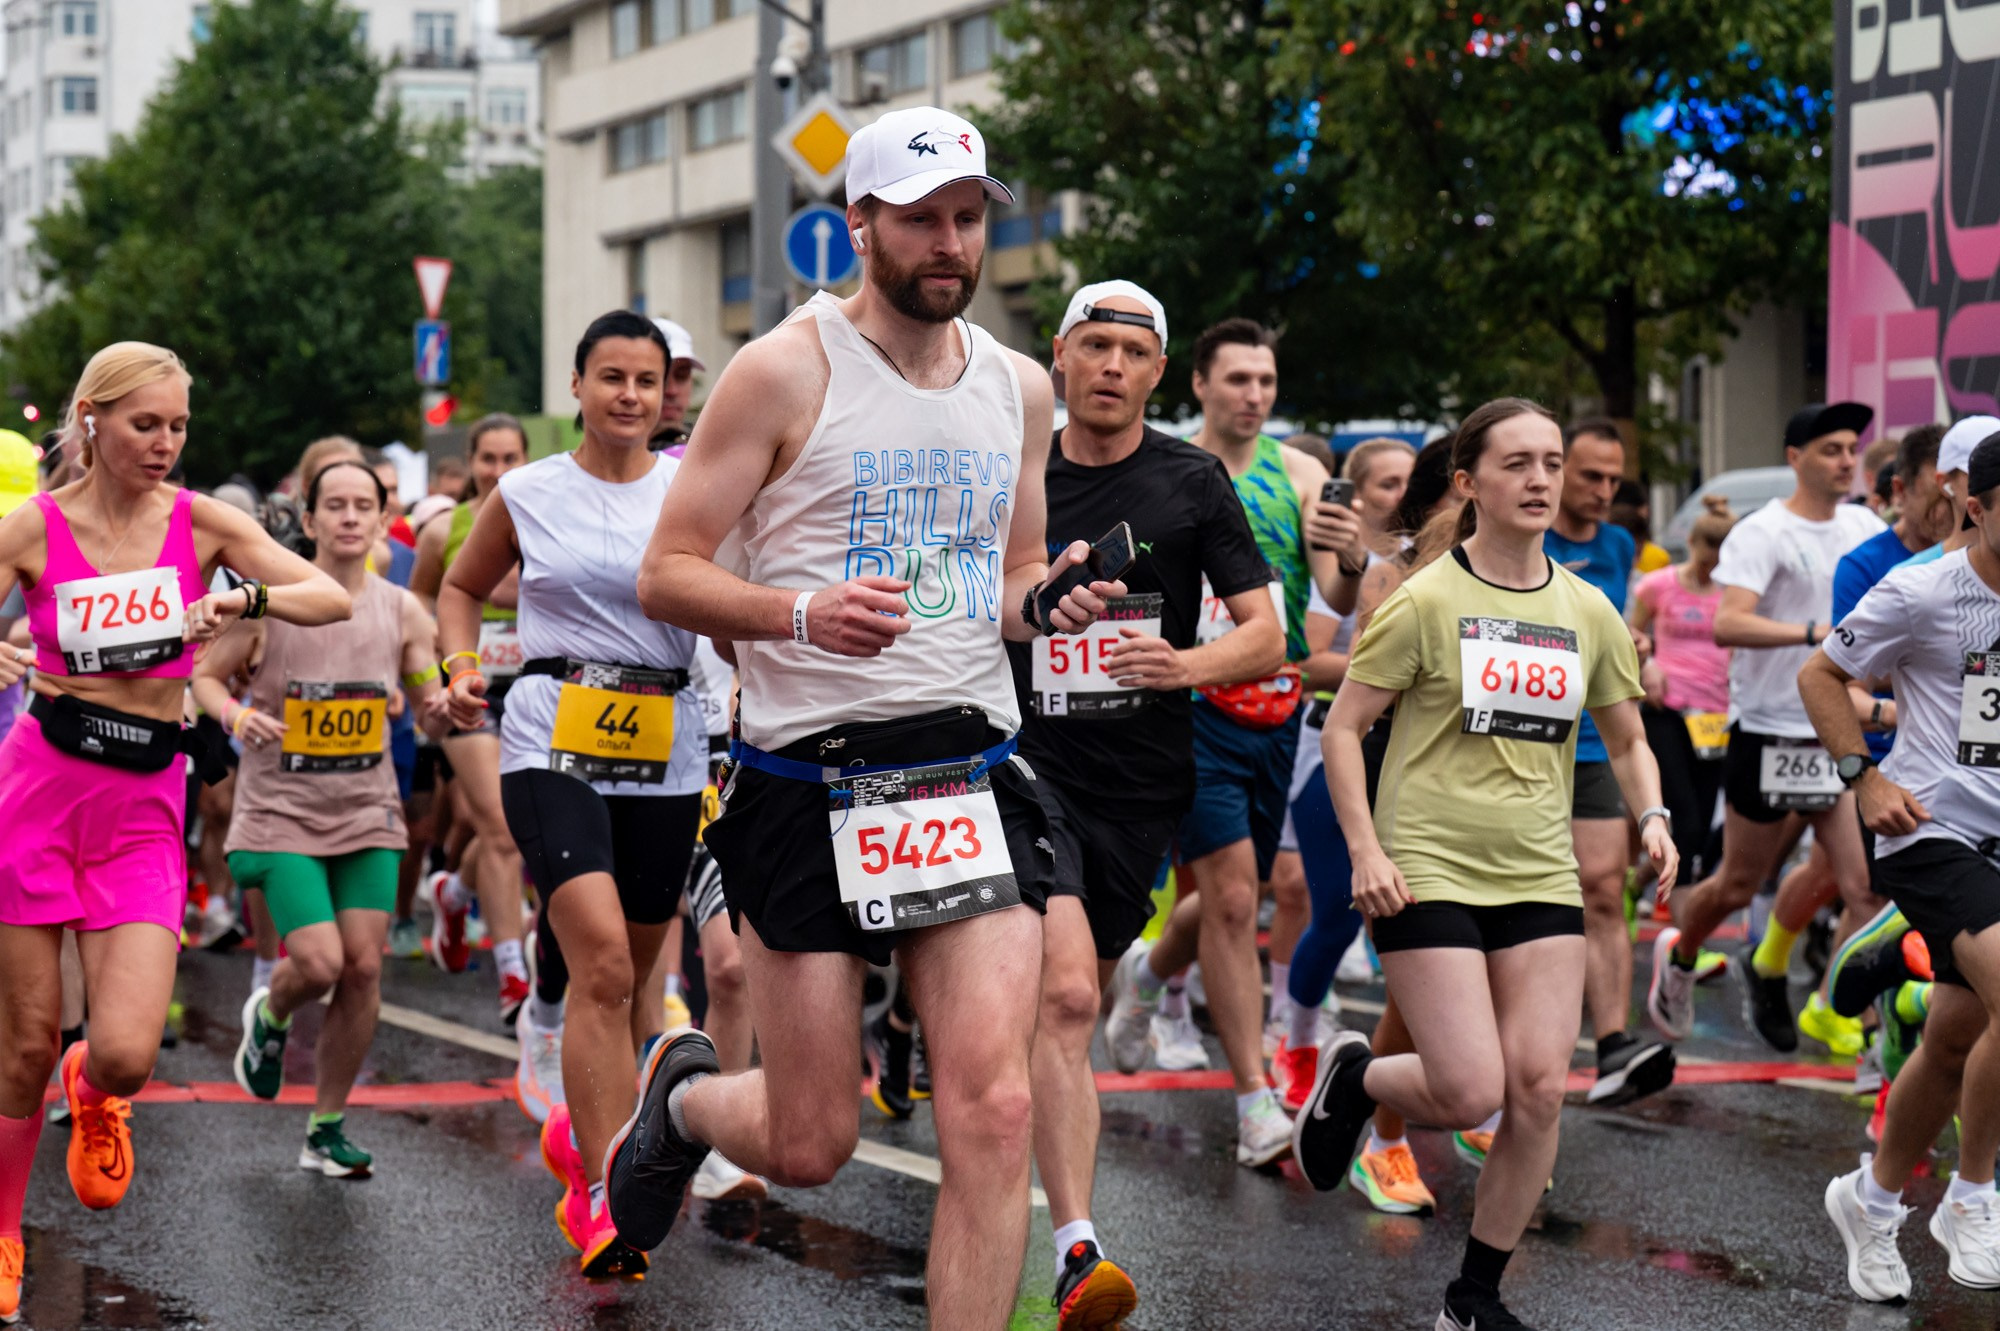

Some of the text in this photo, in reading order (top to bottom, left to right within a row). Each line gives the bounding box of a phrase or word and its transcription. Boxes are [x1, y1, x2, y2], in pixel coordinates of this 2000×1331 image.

[854, 449, 1013, 488] BIBIREVO
[850, 488, 1008, 548] HILLS
[72, 586, 169, 632] 7266
[795, 610, 804, 641] 5423
[81, 651, 94, 669] F
[481, 642, 523, 666] 625
[1050, 639, 1120, 674] 515
[1481, 657, 1567, 701] 6183
[1050, 693, 1061, 713] F
[301, 708, 373, 737] 1600
[595, 702, 640, 738] 44
[1475, 711, 1489, 729] F
[291, 755, 304, 771] F
[560, 753, 576, 772] F
[1775, 754, 1834, 778] 2661
[1969, 744, 1985, 764] F
[946, 769, 965, 777] FEST
[908, 780, 967, 800] 15 KM
[857, 816, 982, 875] 5423
[866, 899, 885, 925] C
